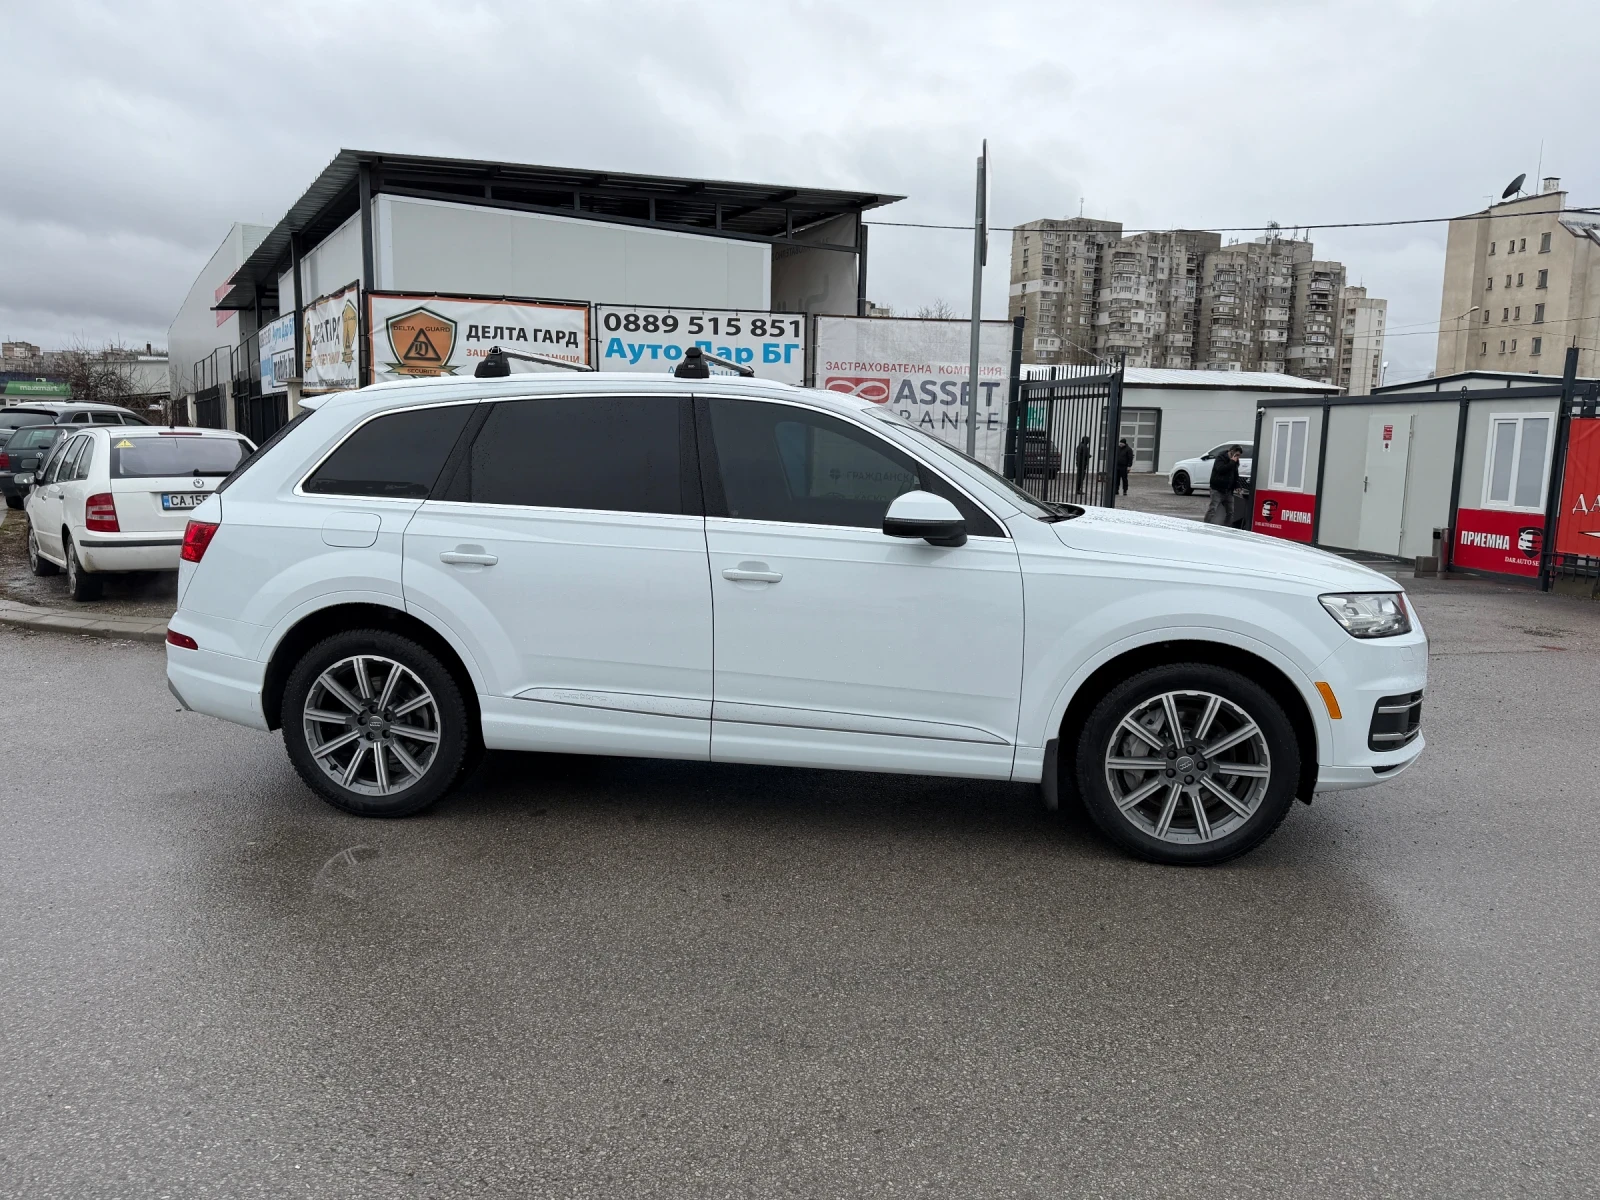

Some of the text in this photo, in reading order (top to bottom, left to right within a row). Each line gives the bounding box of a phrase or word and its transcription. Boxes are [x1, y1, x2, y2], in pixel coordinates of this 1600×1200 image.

[466, 324, 579, 348] ДЕЛТА ГАРД
[603, 312, 800, 338] 0889 515 851
[605, 337, 683, 365] Ауто
[762, 342, 800, 364] БГ
[825, 361, 1002, 376] ЗАСТРАХОВАТЕЛНА КОМПНИЯ
[893, 379, 1001, 407] ASSET
[900, 410, 999, 431] RANCE
[1281, 509, 1312, 525] ПРИЕМНА
[1460, 530, 1510, 550] ПРИЕМНА
